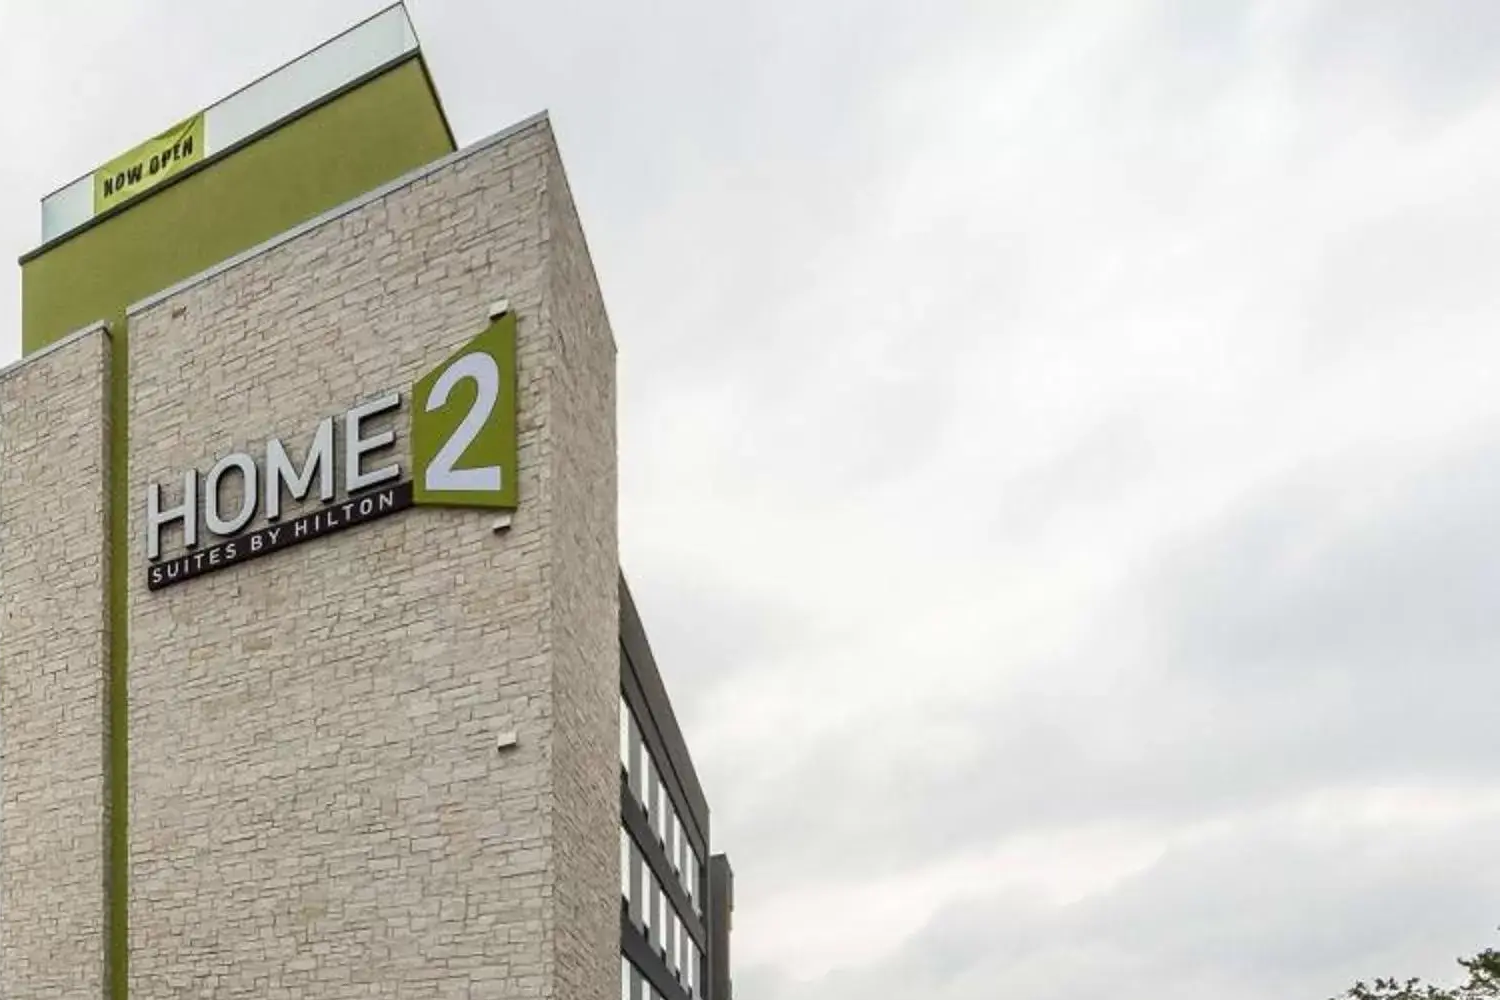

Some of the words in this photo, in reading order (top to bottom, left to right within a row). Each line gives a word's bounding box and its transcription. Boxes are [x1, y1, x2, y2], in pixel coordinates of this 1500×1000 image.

[103, 163, 143, 198] NOW
[148, 135, 193, 175] OPEN
[148, 393, 400, 561] HOME
[424, 351, 501, 491] 2
[152, 543, 237, 583] SUITES
[251, 527, 281, 551] BY
[294, 490, 395, 537] HILTON
